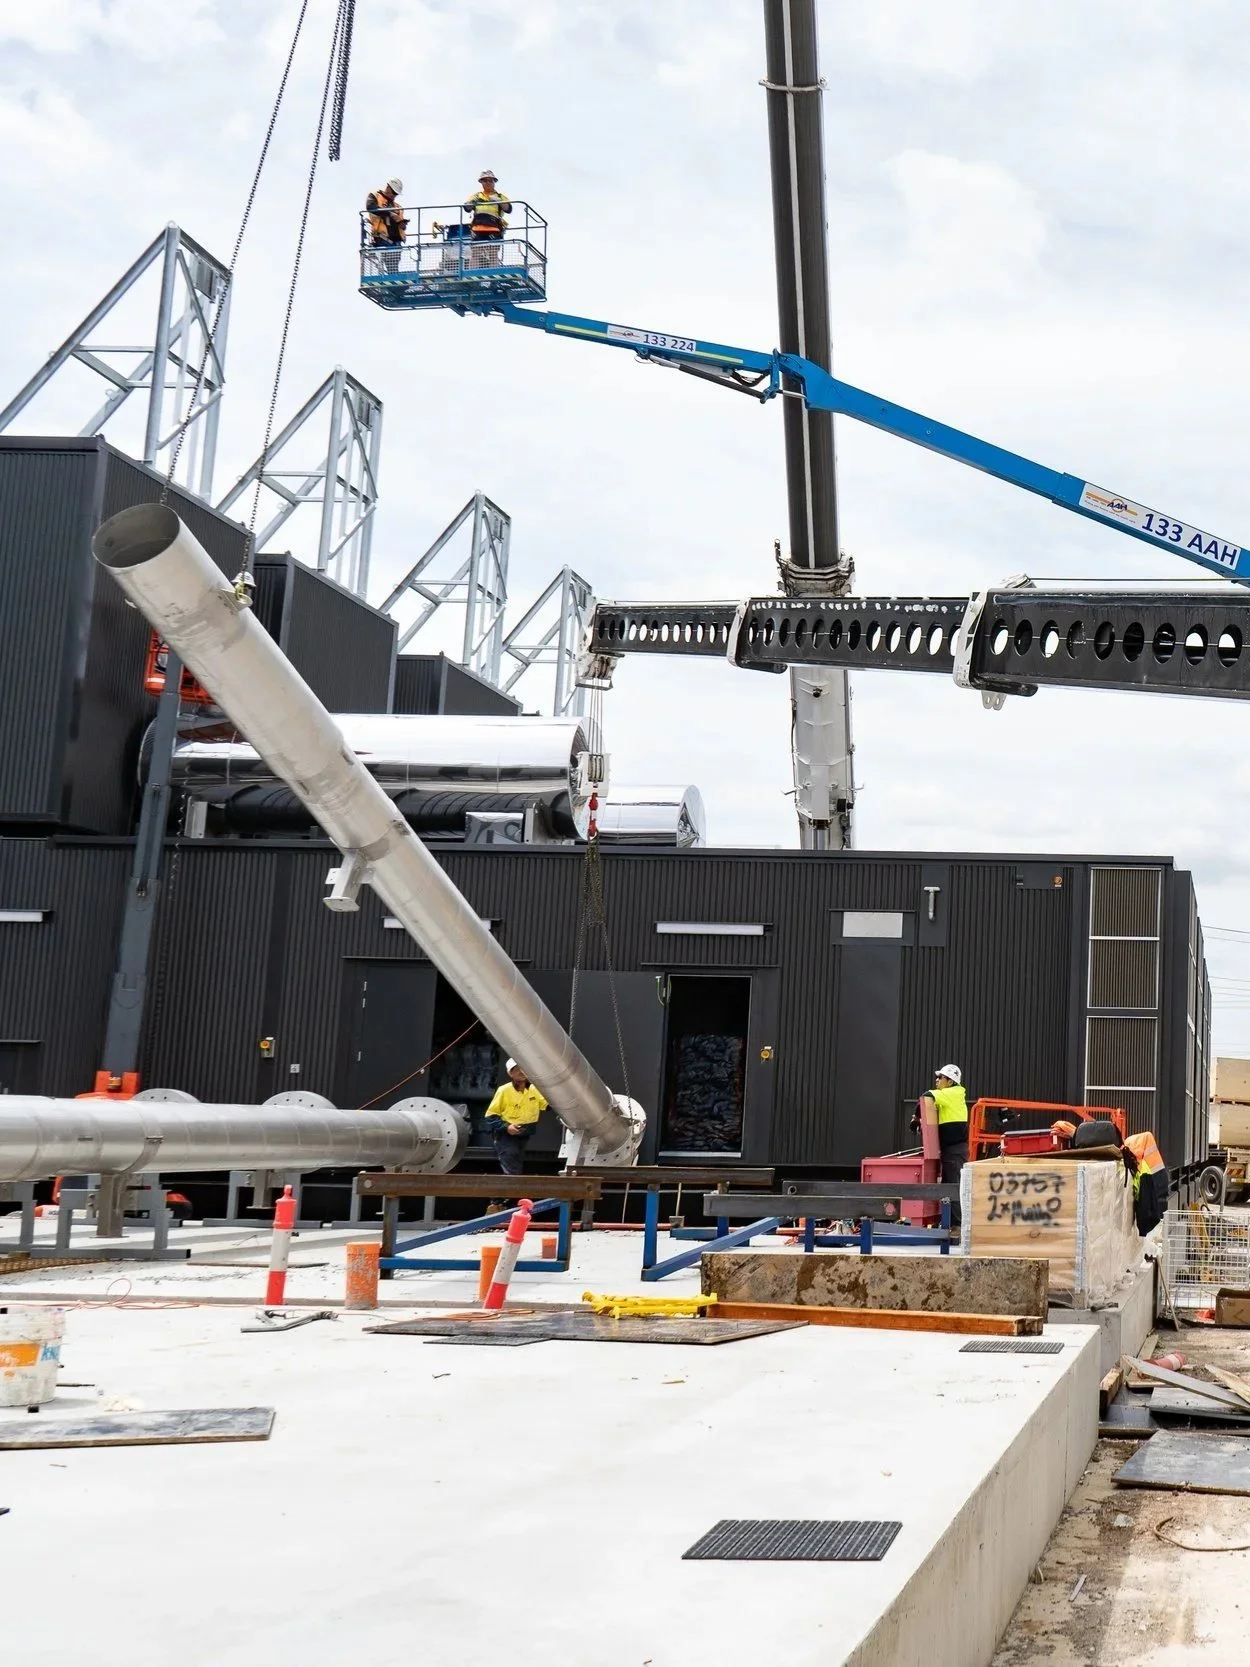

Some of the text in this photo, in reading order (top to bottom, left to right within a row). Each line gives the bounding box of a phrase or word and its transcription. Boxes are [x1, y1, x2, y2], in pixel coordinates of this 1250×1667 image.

[643, 334, 667, 347] 133
[670, 338, 694, 352] 224
[1141, 513, 1238, 566] 133 AAH
[989, 1171, 1066, 1195] 03757
